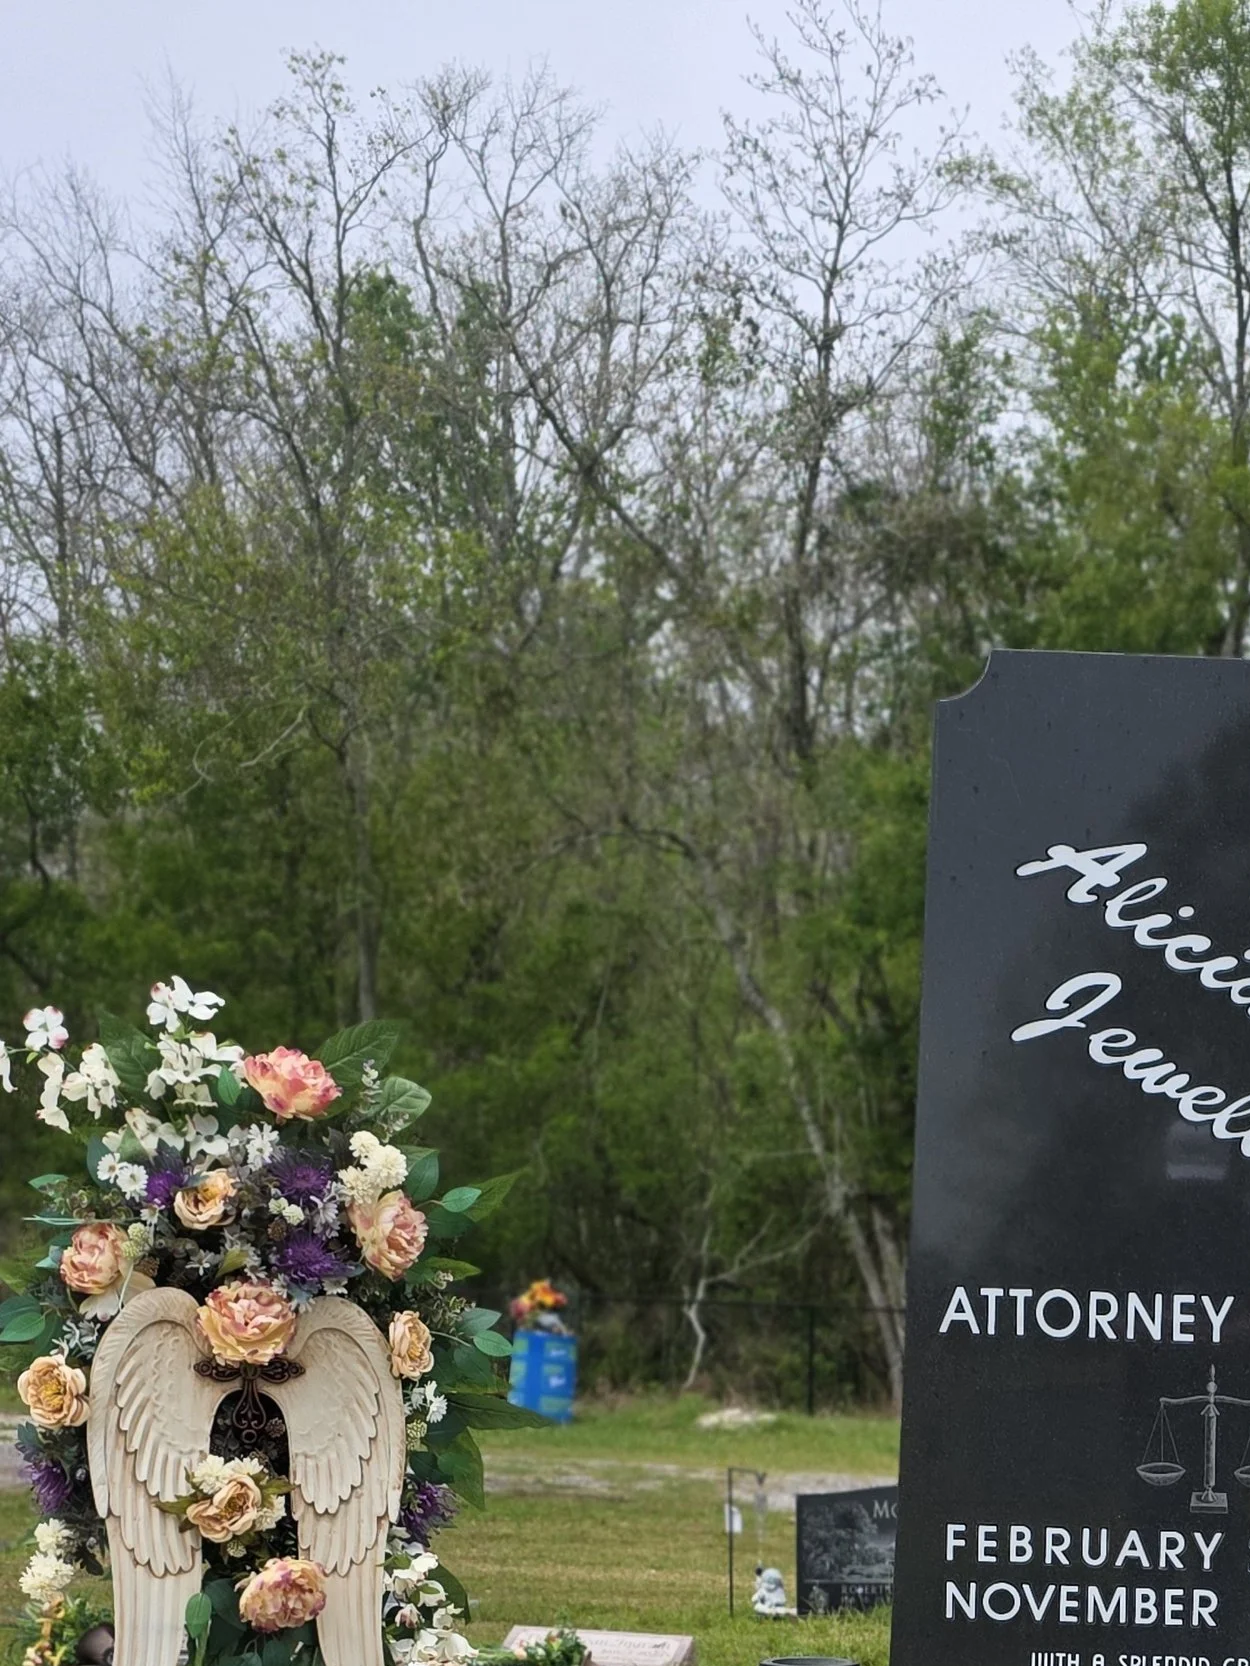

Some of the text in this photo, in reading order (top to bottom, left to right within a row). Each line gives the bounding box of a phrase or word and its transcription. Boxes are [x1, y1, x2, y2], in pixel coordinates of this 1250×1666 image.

[939, 1287, 1234, 1342] ATTORNEY
[946, 1523, 1223, 1569] FEBRUARY
[945, 1581, 1218, 1627] NOVEMBER
